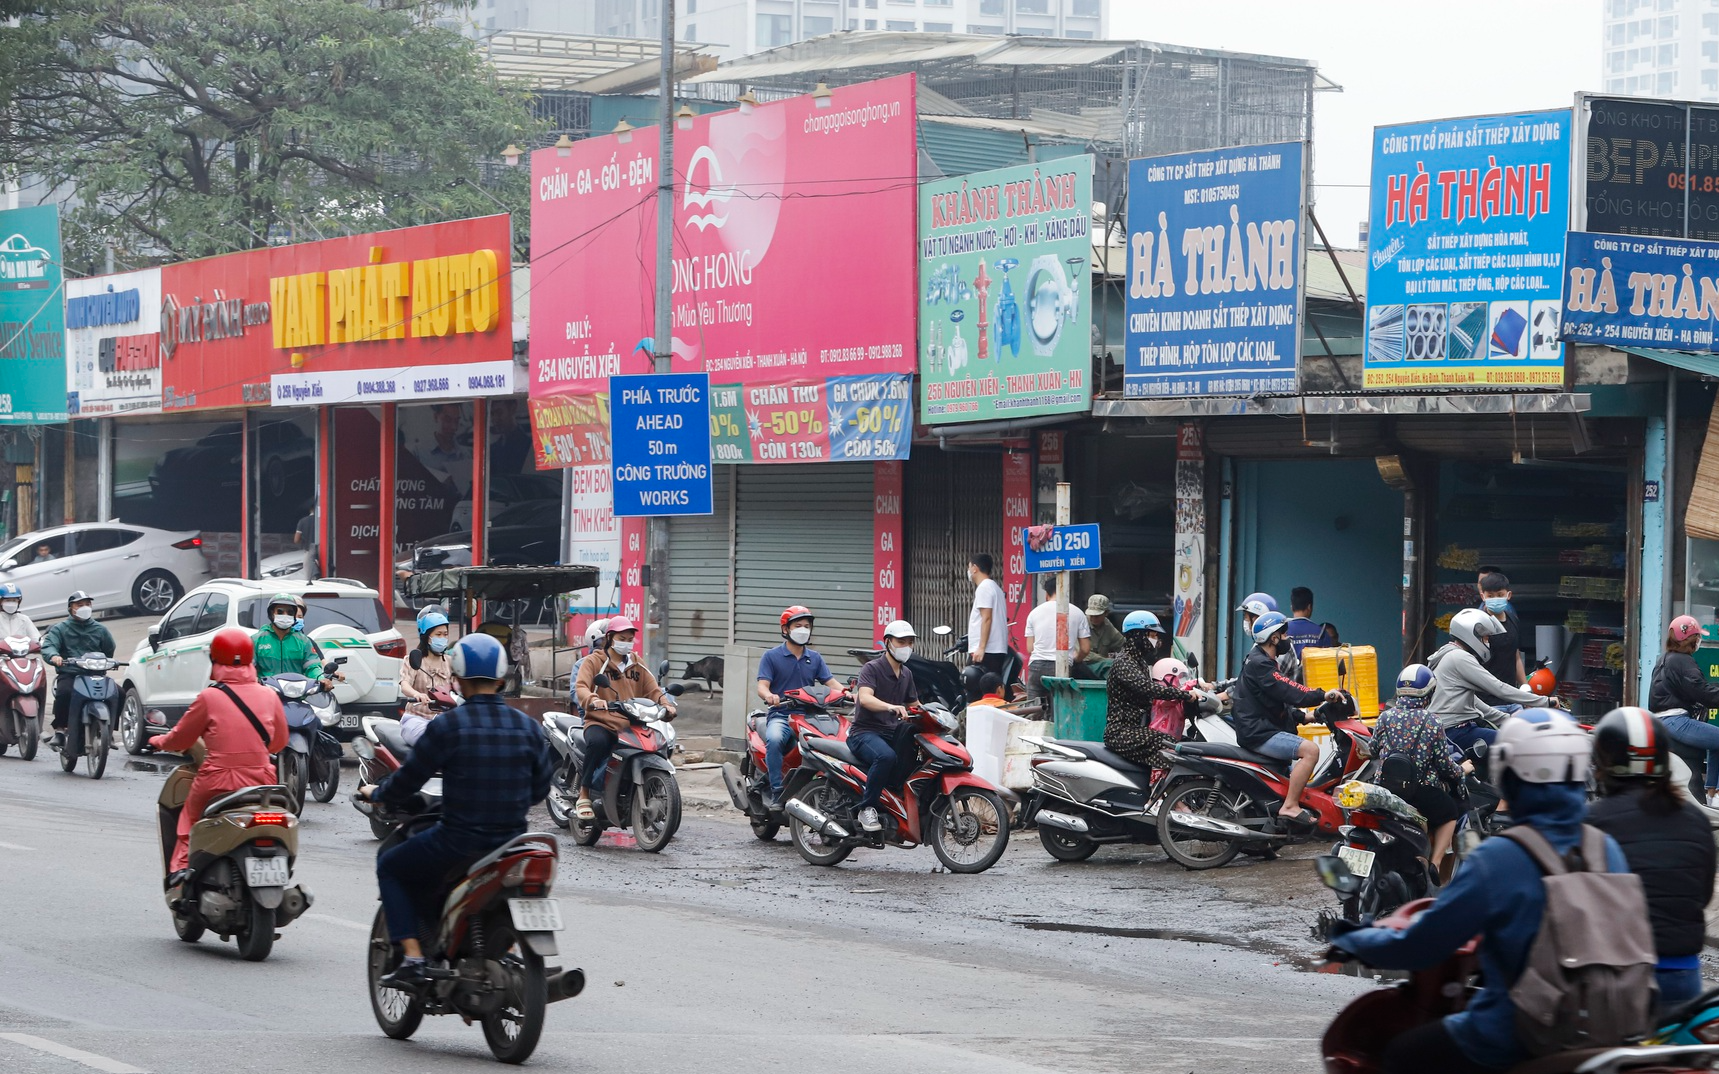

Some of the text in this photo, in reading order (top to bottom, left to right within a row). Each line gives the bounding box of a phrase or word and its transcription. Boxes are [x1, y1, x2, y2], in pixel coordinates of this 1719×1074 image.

[1631, 113, 1660, 129] KHO
[1383, 121, 1560, 154] CÔNG TY CỔ PHẦN SẮT THÉP XÂY DỰNG
[540, 152, 653, 201] CHĂN GA GỐI ĐỆM
[1148, 152, 1281, 182] CÔNG TY CP SẮT THÉP XÂY DỰNG HÀ THÀNH
[931, 168, 1077, 230] KHÁNH THÀNH
[1184, 189, 1200, 205] MST:
[1386, 155, 1551, 230] HÀ THÀNH
[1638, 200, 1673, 218] KHO
[923, 210, 1087, 262] VẬT TƯ NGÀNH NƯỚC HƠI KHÍ XĂNG DẦU
[1427, 230, 1508, 250] SẮT THÉP XÂY DỰNG HÒA
[1130, 203, 1296, 300] HÀ THÀNH
[1594, 239, 1706, 259] CÔNG TY CP SẮT THÉP XÂY
[672, 250, 752, 294] ONG HONG
[1398, 251, 1542, 274] TÔN LỢP CÁC SẮT THÉP CÁC LOẠI HÌNH
[1405, 274, 1525, 296] ĐẠI LÝ TÔN THÉP HỘP CÁC
[1567, 256, 1619, 314] HÀ
[270, 271, 326, 368] VẠN
[328, 246, 410, 344] PHÁT
[411, 249, 499, 339] AUTO
[697, 301, 715, 327] Yêu
[716, 299, 753, 328] Thương
[1130, 301, 1293, 333] CHUYÊN KINH DOANH SẮT THÉP XÂY DỰNG
[30, 320, 62, 360] Service
[566, 322, 579, 344] ĐẠI
[1577, 322, 1713, 346] 252 254 NGUYỄN XIỂN HẠ ĐÌNH
[538, 342, 620, 382] 254 NGUYỄN XIỂN
[1139, 337, 1254, 369] THÉP HÌNH, HỘP TÔN LỢP CÁC
[622, 384, 700, 405] PHÍA TRƯỚC
[751, 384, 819, 406] CHĂN THU
[834, 384, 849, 403] GA
[927, 383, 942, 401] 256
[944, 373, 977, 399] NGUYỄN
[1006, 374, 1035, 394] THANH
[1037, 369, 1062, 391] XUÂN
[1069, 369, 1083, 388] HN
[713, 390, 737, 408] 1.6M
[636, 414, 683, 430] AHEAD
[763, 410, 823, 436] -50%
[554, 433, 581, 463] 50%
[759, 436, 787, 459] CÒN
[844, 437, 872, 458] CÒN
[616, 461, 707, 481] CÔNG TRƯỜNG
[350, 477, 380, 492] CHẤT
[1645, 484, 1658, 498] 252
[420, 495, 444, 509] TẦM
[639, 490, 689, 506] WORKS
[876, 490, 899, 515] CHĂN
[1006, 493, 1028, 517] CHĂN
[351, 525, 379, 539] DỊCH
[573, 508, 591, 533] TINH
[629, 533, 640, 552] GA
[881, 532, 893, 551] GA
[1011, 526, 1023, 546] GA
[1036, 531, 1090, 553] GÕ 250
[1040, 554, 1086, 568] NGUYỄN XIỂN
[626, 560, 640, 587] GỐI
[879, 560, 894, 589] GỐI
